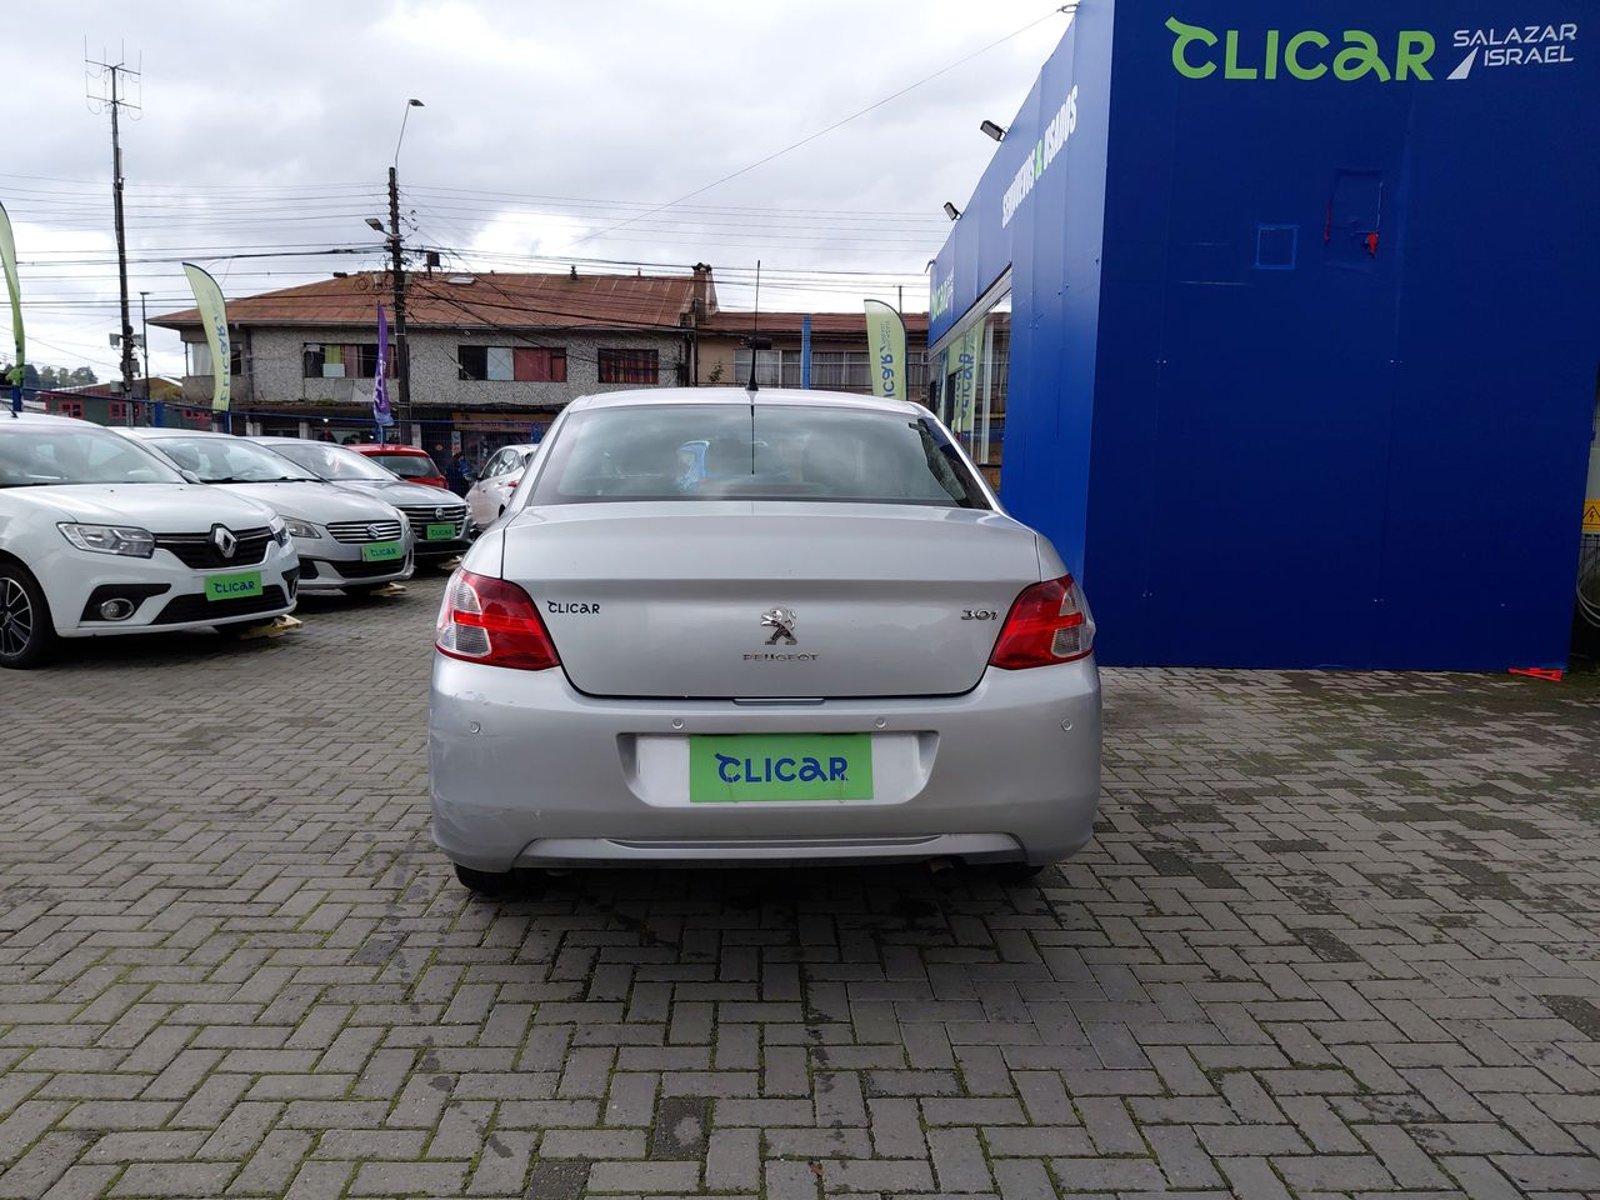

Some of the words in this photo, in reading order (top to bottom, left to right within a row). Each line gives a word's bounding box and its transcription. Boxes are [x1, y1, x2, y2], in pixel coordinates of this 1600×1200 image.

[1453, 23, 1578, 47] SALAZAR
[1484, 45, 1574, 66] ISRAEL
[743, 653, 819, 661] PEUGEOT
